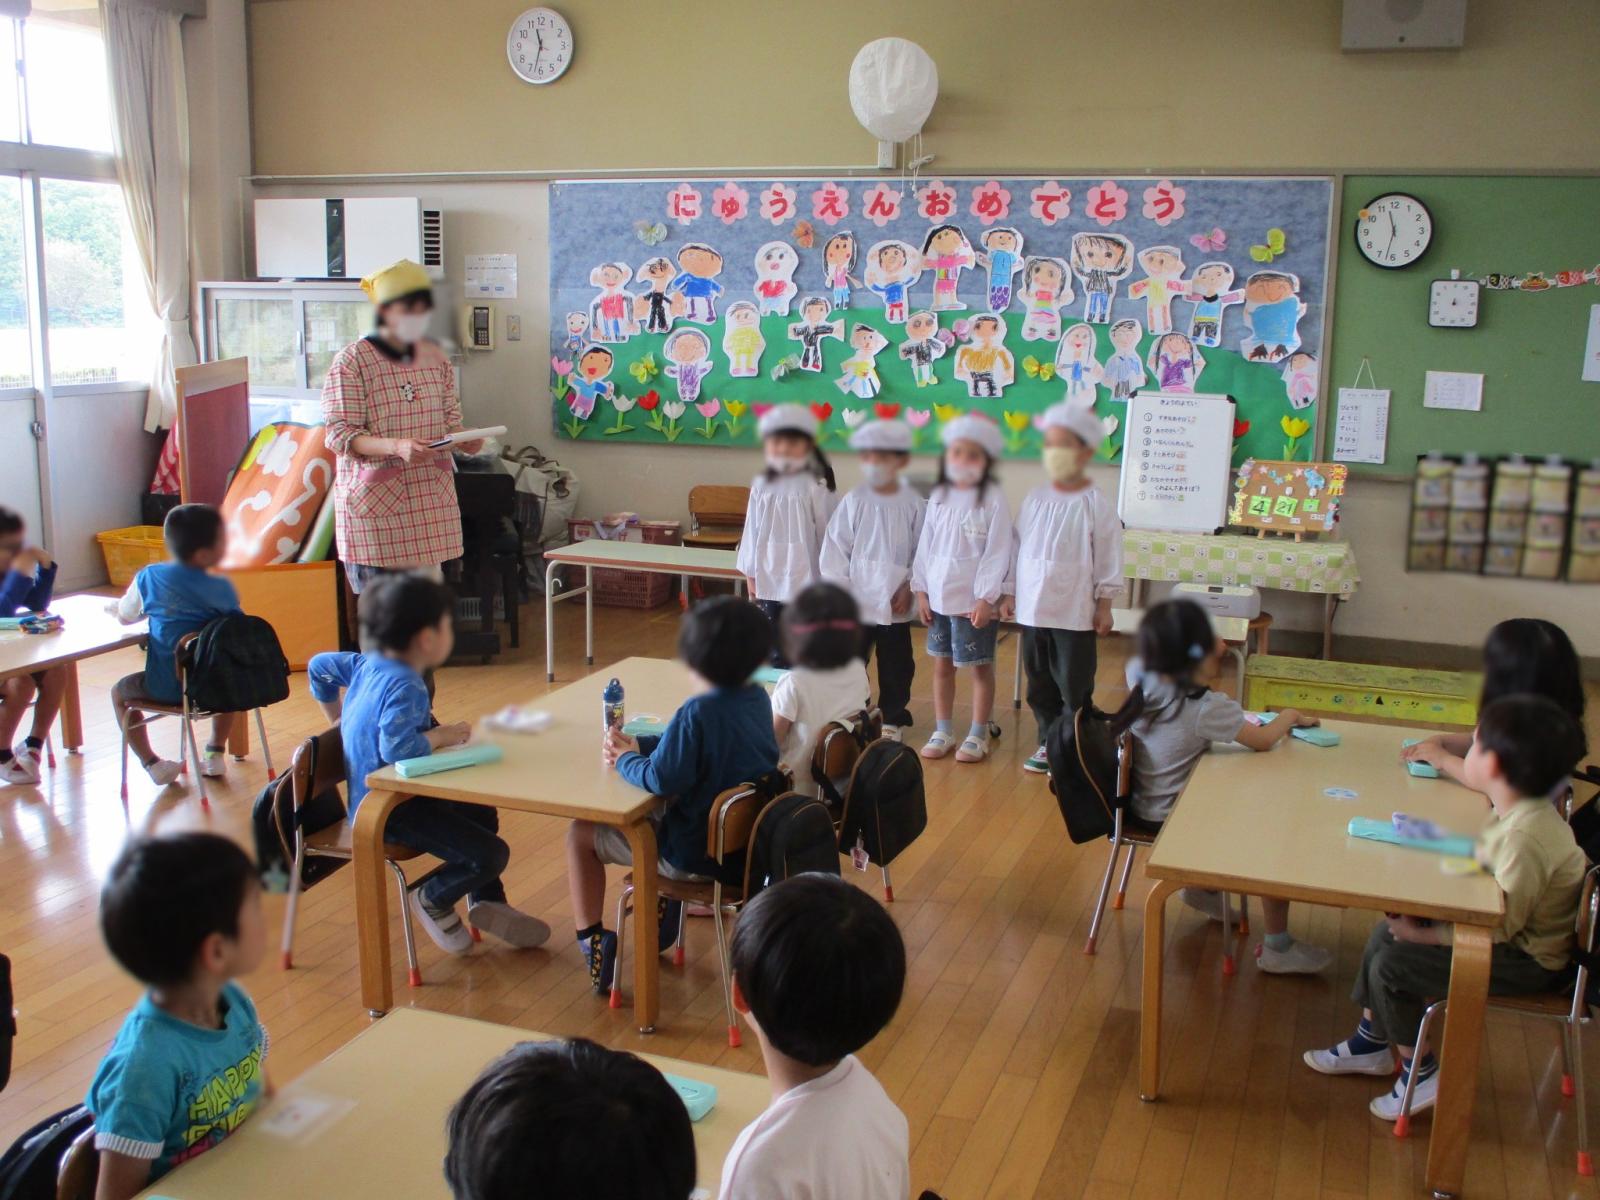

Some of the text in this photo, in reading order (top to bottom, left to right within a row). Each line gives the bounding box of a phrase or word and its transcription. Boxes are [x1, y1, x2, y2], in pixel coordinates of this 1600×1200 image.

[527, 20, 535, 29] 11
[537, 16, 546, 26] 12
[550, 19, 554, 28] 1
[519, 29, 528, 39] 10
[557, 28, 563, 38] 2
[516, 42, 522, 51] 9
[560, 41, 566, 50] 3
[519, 54, 526, 63] 8
[556, 54, 562, 62] 4
[527, 63, 533, 72] 7
[538, 66, 544, 75] 6
[549, 63, 555, 72] 5
[674, 188, 1176, 220] にゅうえんおめでとう
[1252, 500, 1265, 514] 4
[1276, 501, 1293, 514] 21
[187, 1043, 263, 1121] HAPPY
